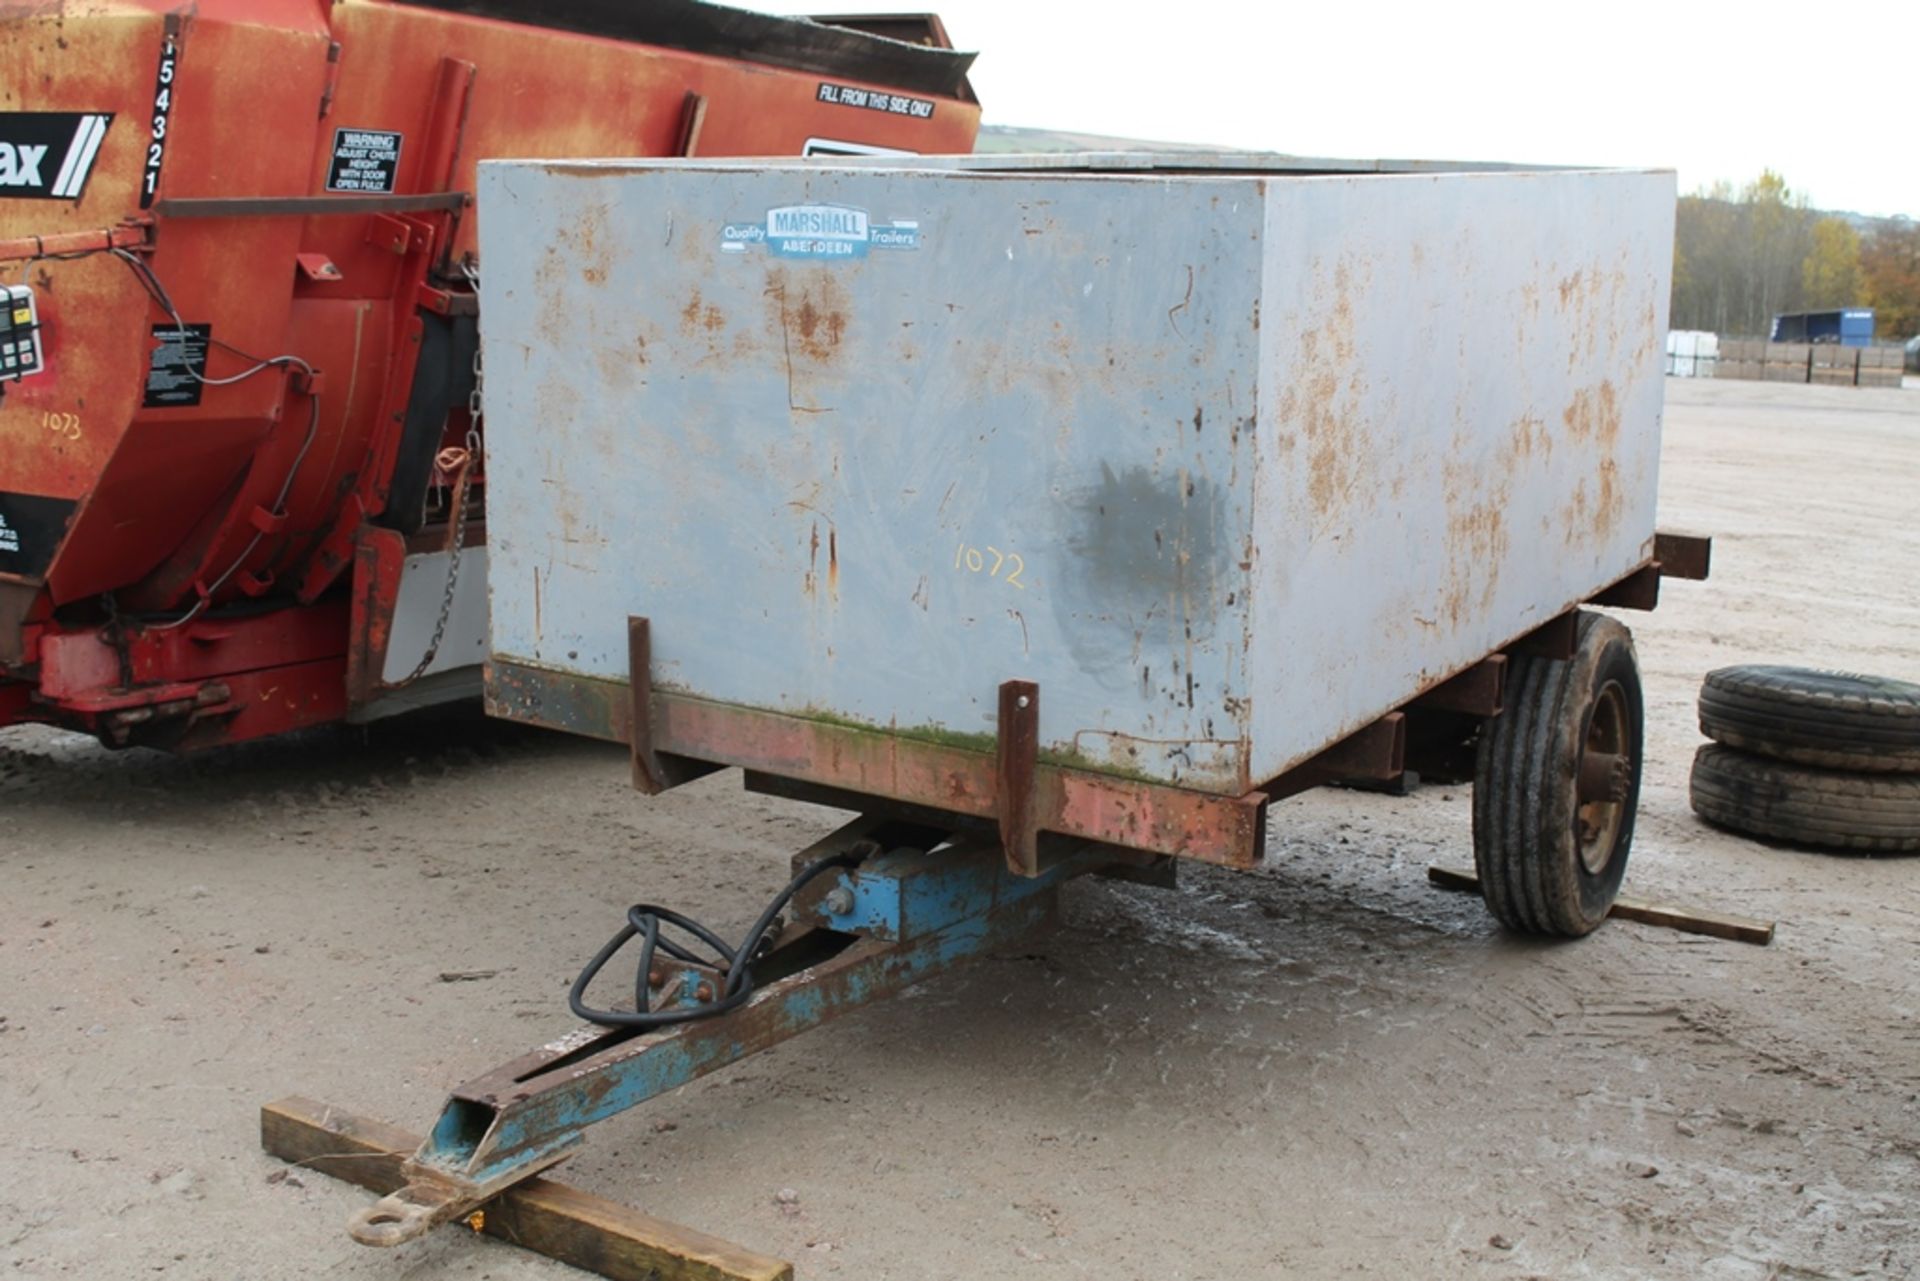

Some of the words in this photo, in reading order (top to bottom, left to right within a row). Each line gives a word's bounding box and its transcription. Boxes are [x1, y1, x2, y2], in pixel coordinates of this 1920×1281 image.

[160, 60, 174, 83] 5
[156, 88, 169, 111] 4
[820, 84, 839, 102] FILL
[841, 87, 868, 107] FROM
[868, 92, 889, 111] THIS
[888, 96, 910, 114] SIDE
[909, 100, 933, 117] ONLY
[153, 116, 166, 139] 3
[344, 132, 395, 149] WARNING
[148, 143, 162, 166] 2
[335, 179, 359, 189] OPEN
[362, 169, 387, 180] DOOR
[774, 212, 862, 235] MARSHALL
[724, 225, 766, 242] Quality
[870, 229, 914, 246] Trailers
[42, 411, 81, 440] 1073
[955, 543, 1025, 590] 1072
